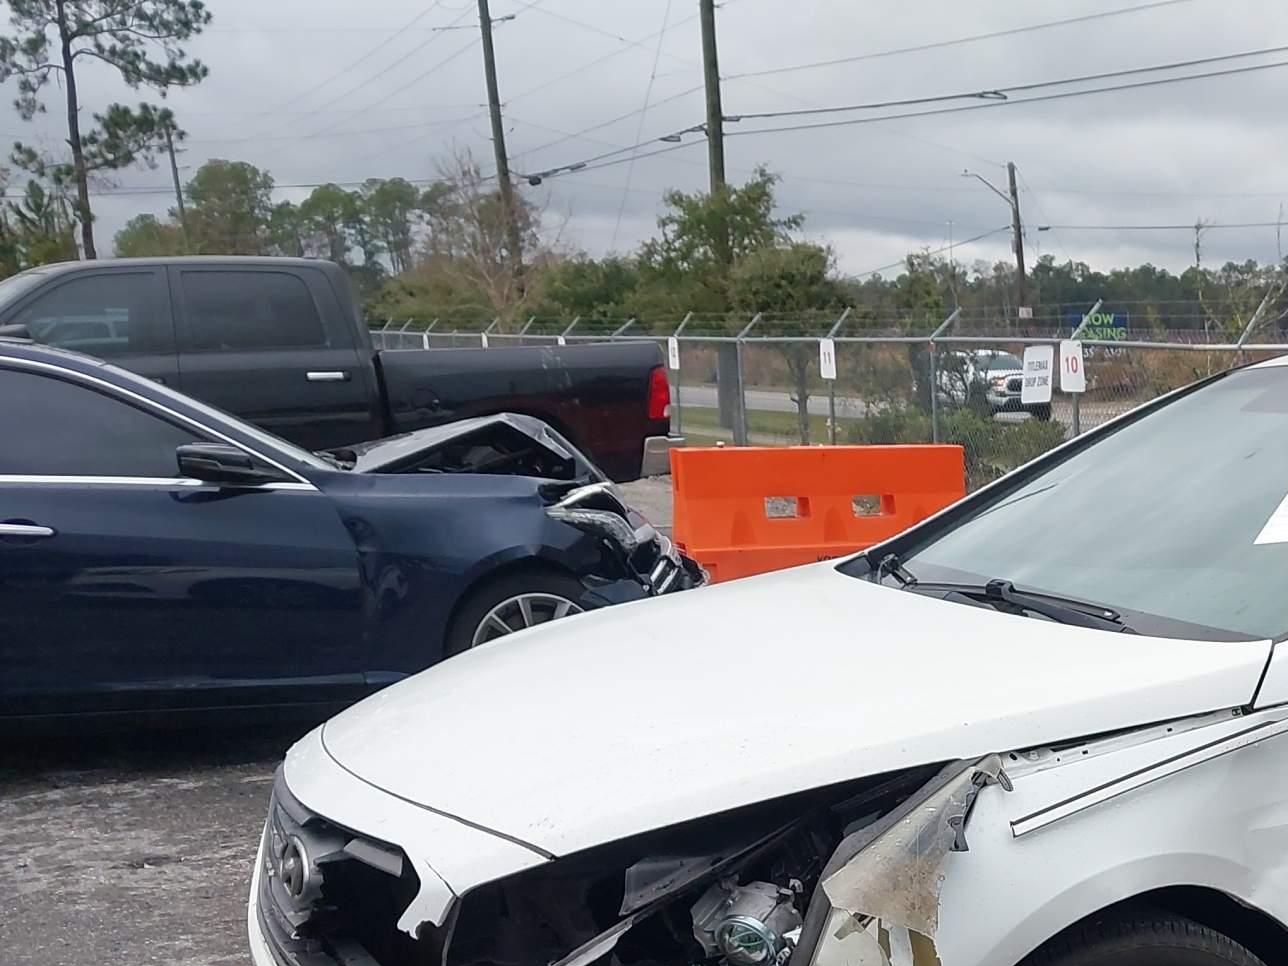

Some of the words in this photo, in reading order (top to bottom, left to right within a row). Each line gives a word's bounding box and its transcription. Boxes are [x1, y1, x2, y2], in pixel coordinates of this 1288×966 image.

[1071, 327, 1127, 340] EASING
[823, 351, 831, 364] 11
[1064, 356, 1078, 374] 10
